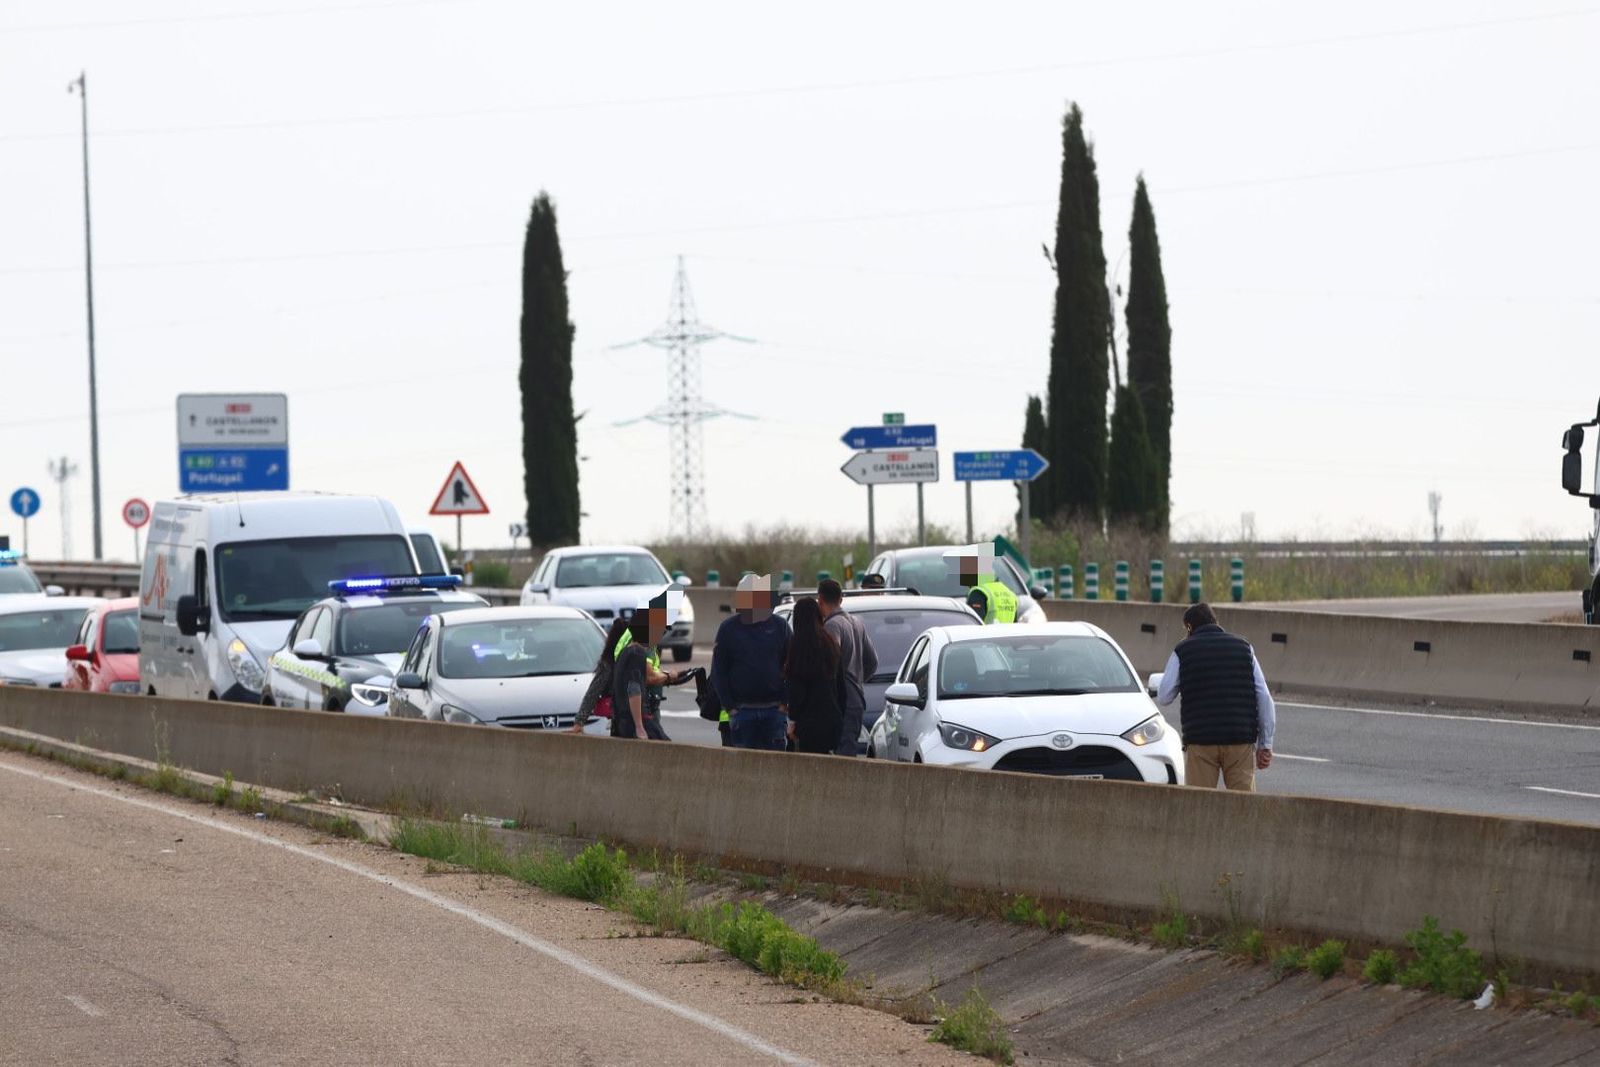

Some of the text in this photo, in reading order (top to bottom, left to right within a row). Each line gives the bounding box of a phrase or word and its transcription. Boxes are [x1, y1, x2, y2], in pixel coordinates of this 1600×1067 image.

[896, 435, 934, 446] Portugal
[873, 462, 935, 472] CASTELLANOS
[189, 472, 243, 486] Portugal
